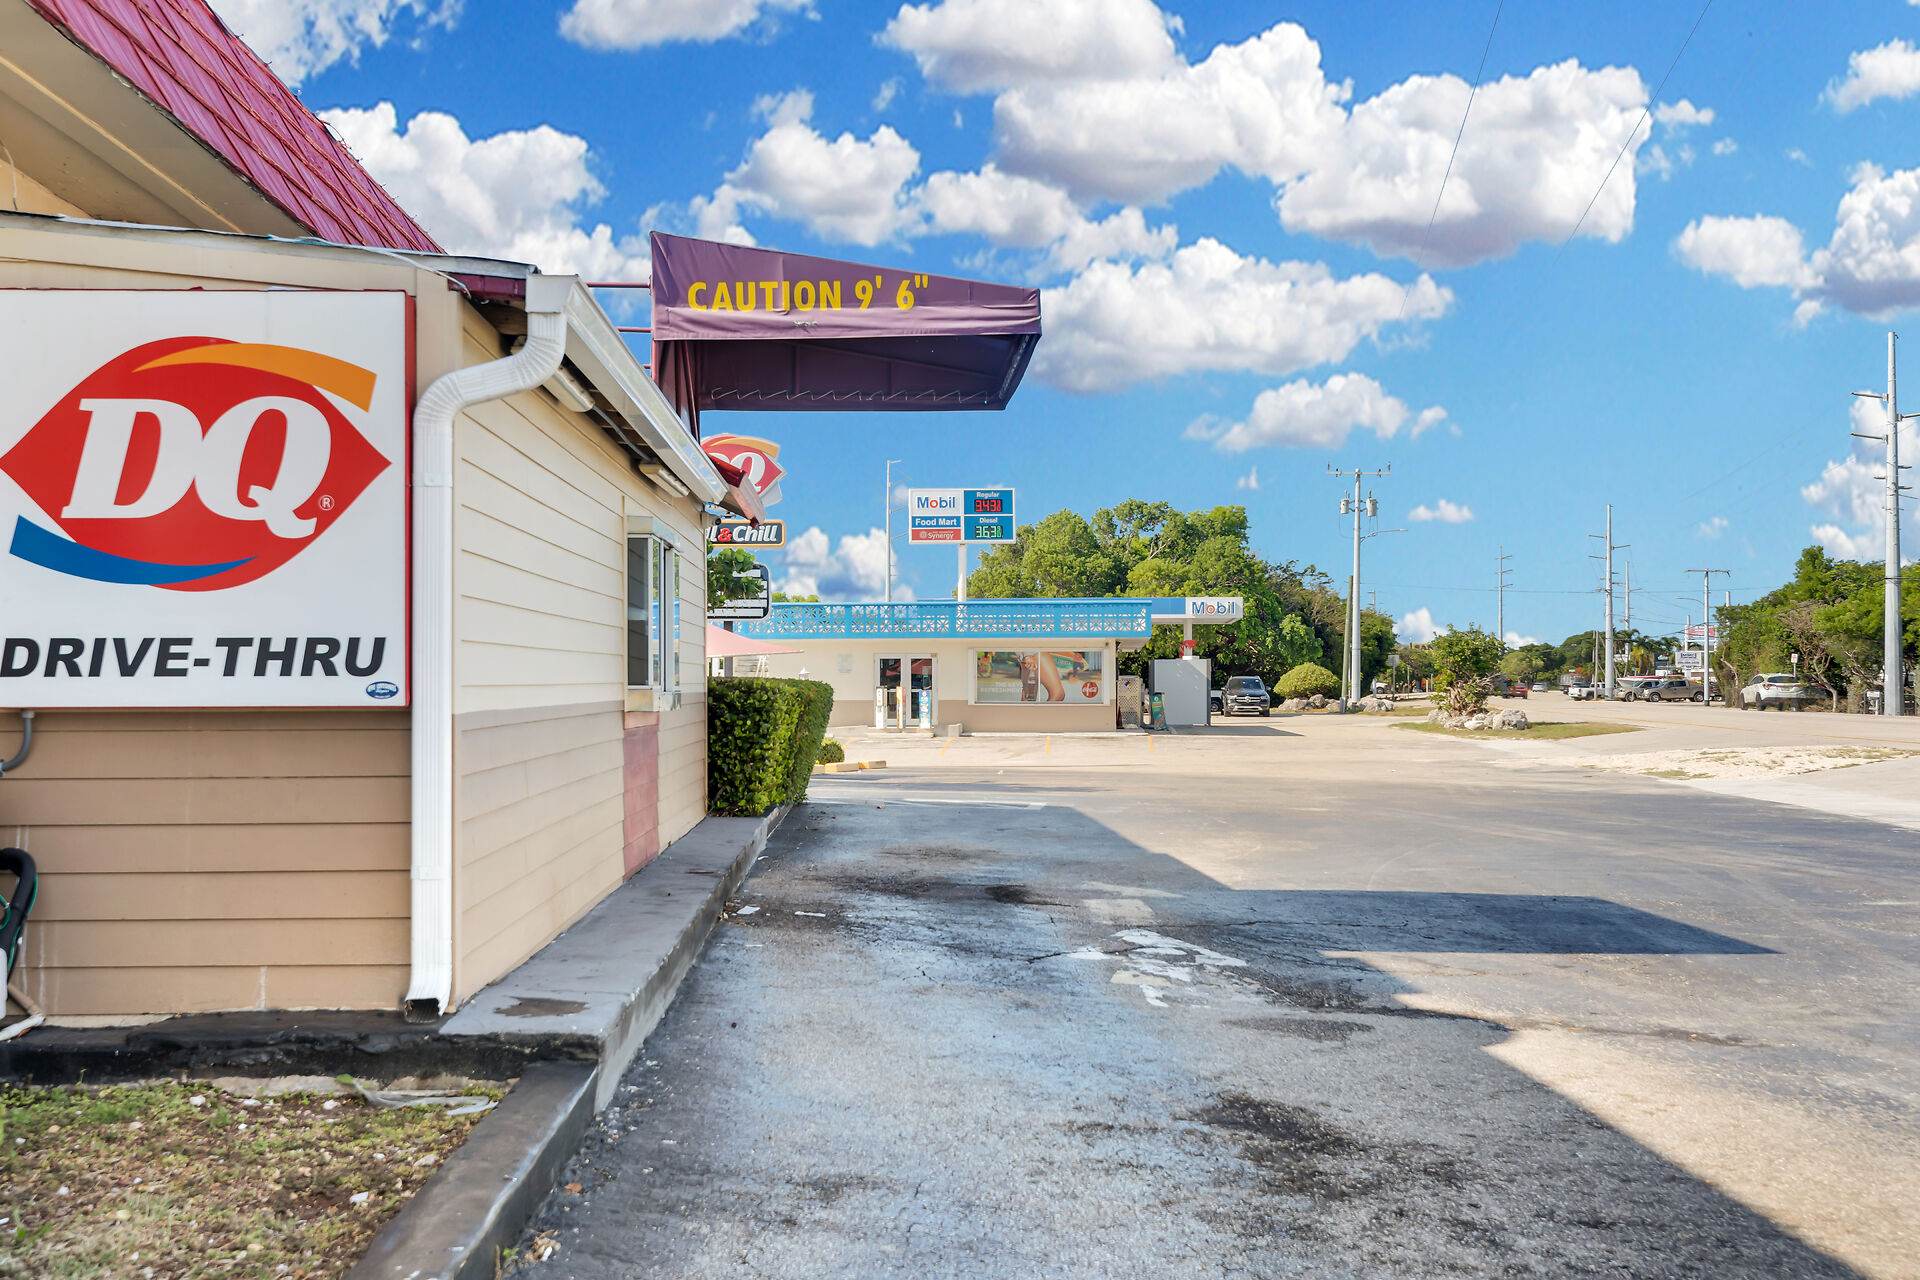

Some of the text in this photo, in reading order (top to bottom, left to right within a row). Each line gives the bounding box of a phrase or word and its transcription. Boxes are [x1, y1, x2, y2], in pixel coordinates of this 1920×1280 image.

[688, 274, 929, 312] CAUTION 9' 6"
[60, 395, 332, 539] DQ
[917, 496, 955, 509] Mobil
[915, 518, 957, 526] Food Mart
[927, 532, 954, 540] Synergy
[1192, 601, 1235, 614] Mobil
[0, 636, 387, 678] DRIVE-THRU
